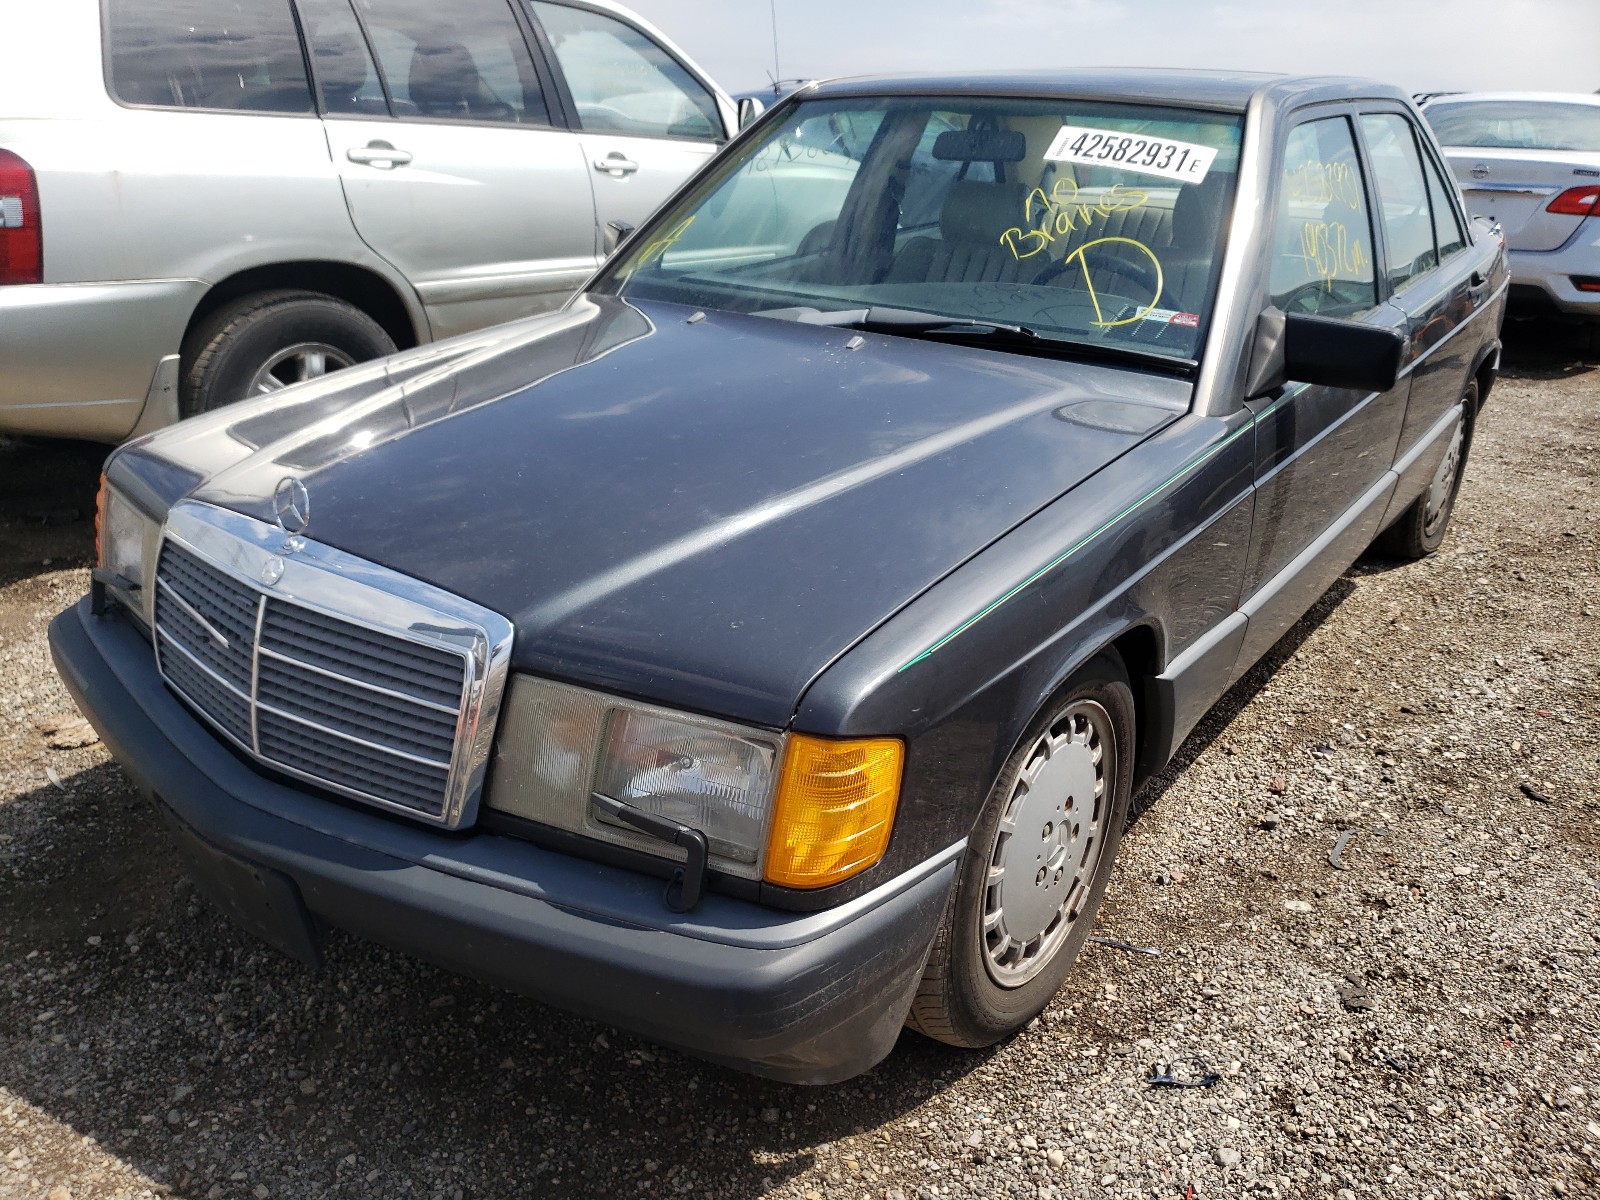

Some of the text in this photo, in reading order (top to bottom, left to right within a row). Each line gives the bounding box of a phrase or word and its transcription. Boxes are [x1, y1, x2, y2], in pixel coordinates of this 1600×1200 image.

[1069, 132, 1191, 172] 42582931
[1189, 160, 1202, 173] E
[1065, 237, 1163, 327] D
